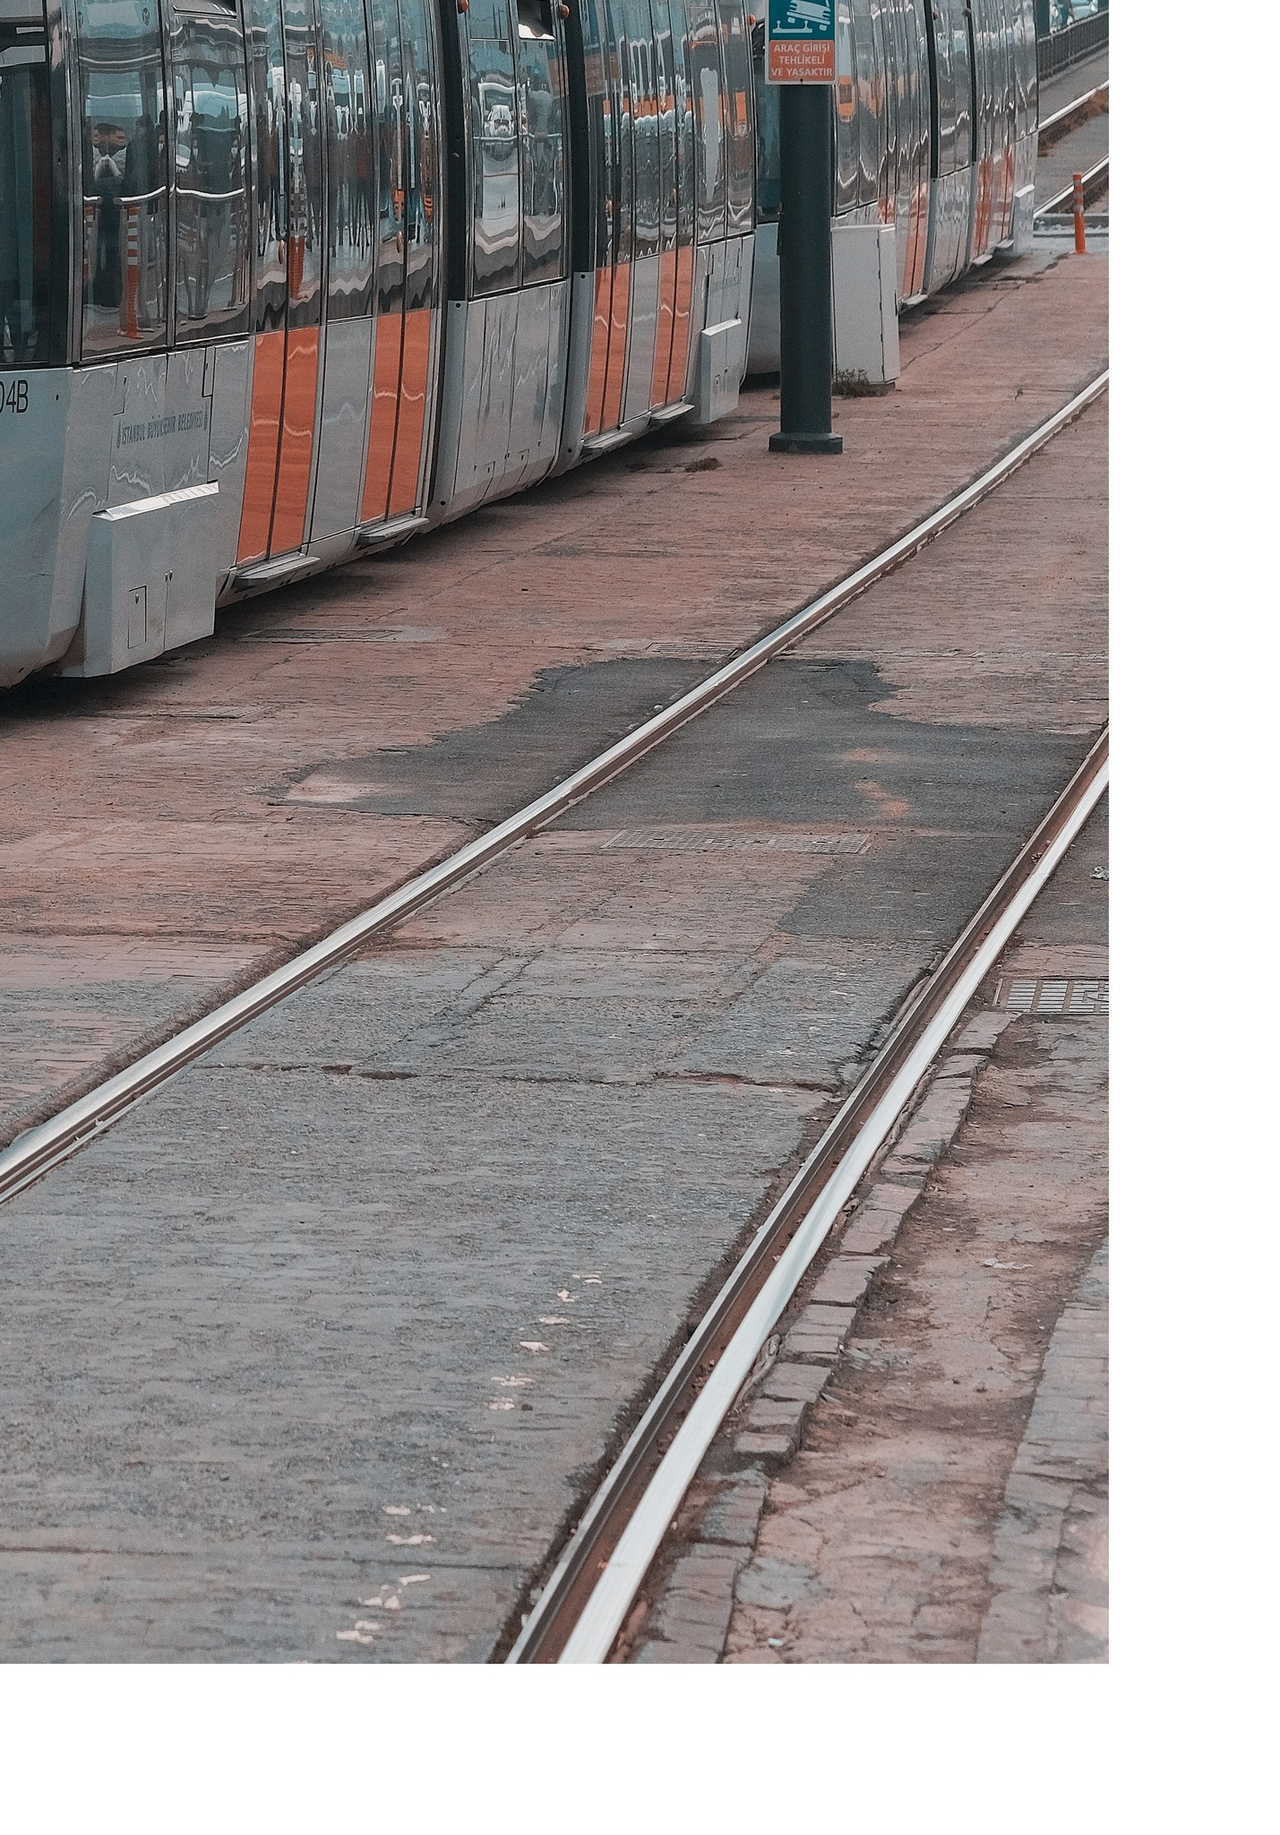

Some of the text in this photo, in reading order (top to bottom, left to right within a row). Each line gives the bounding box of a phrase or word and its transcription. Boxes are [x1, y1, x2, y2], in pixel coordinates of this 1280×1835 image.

[773, 43, 830, 54] ARAÇ GİRİŞİ
[779, 54, 825, 64] TEHLİKELİ
[771, 68, 833, 76] VE YASAKTIR
